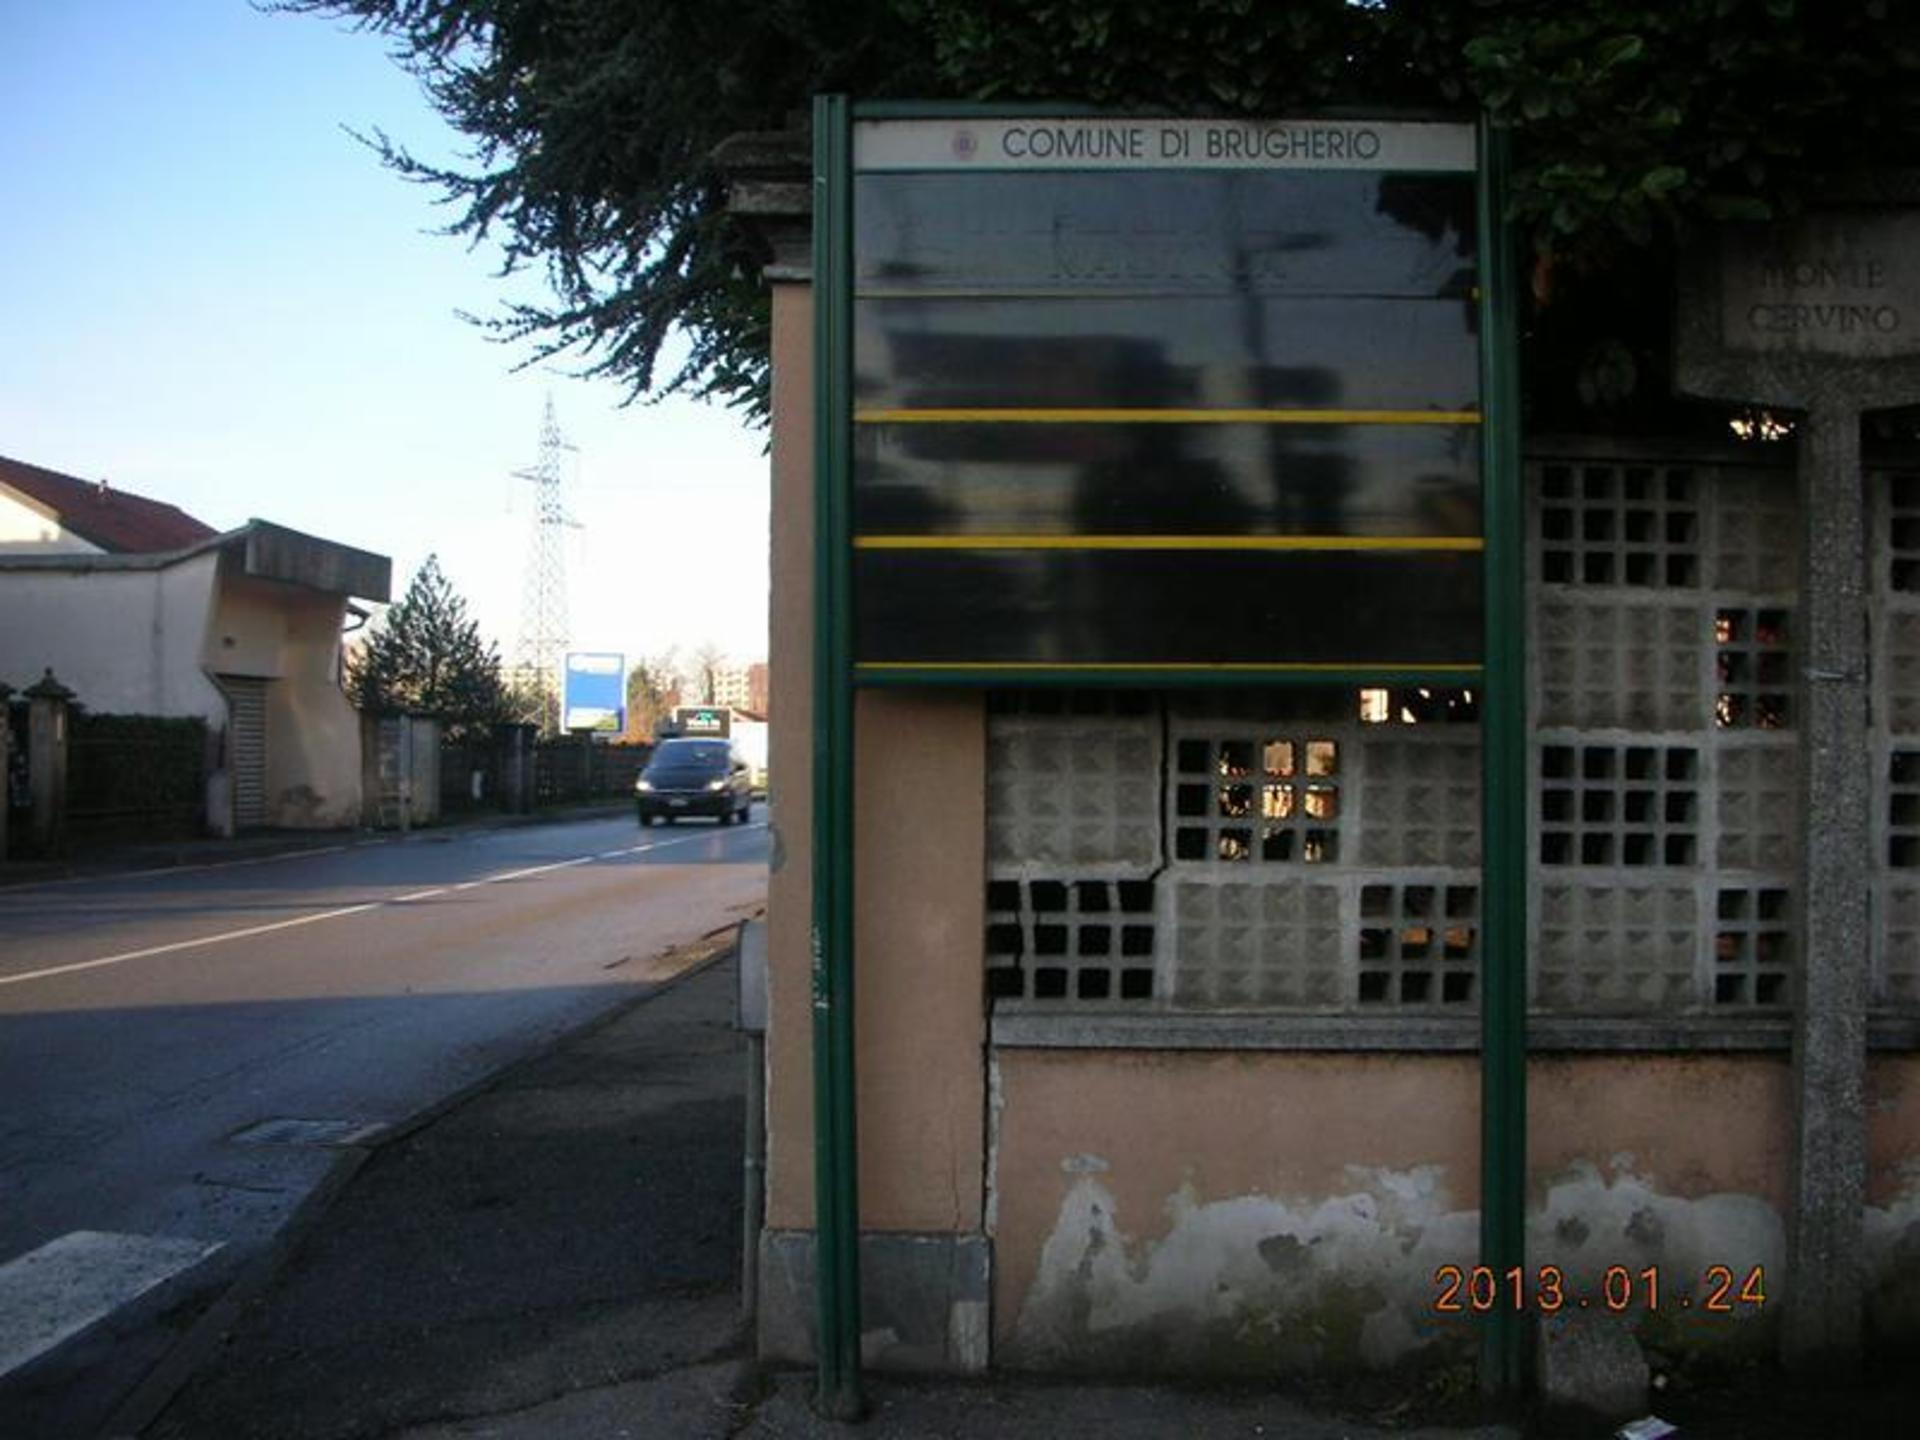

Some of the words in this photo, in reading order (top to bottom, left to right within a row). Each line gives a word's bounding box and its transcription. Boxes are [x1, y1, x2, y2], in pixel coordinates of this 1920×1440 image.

[1002, 128, 1144, 158] COMUNE
[1160, 129, 1190, 159] DI
[1206, 128, 1382, 160] BRUGHERIO
[1747, 304, 1901, 333] CERVINO
